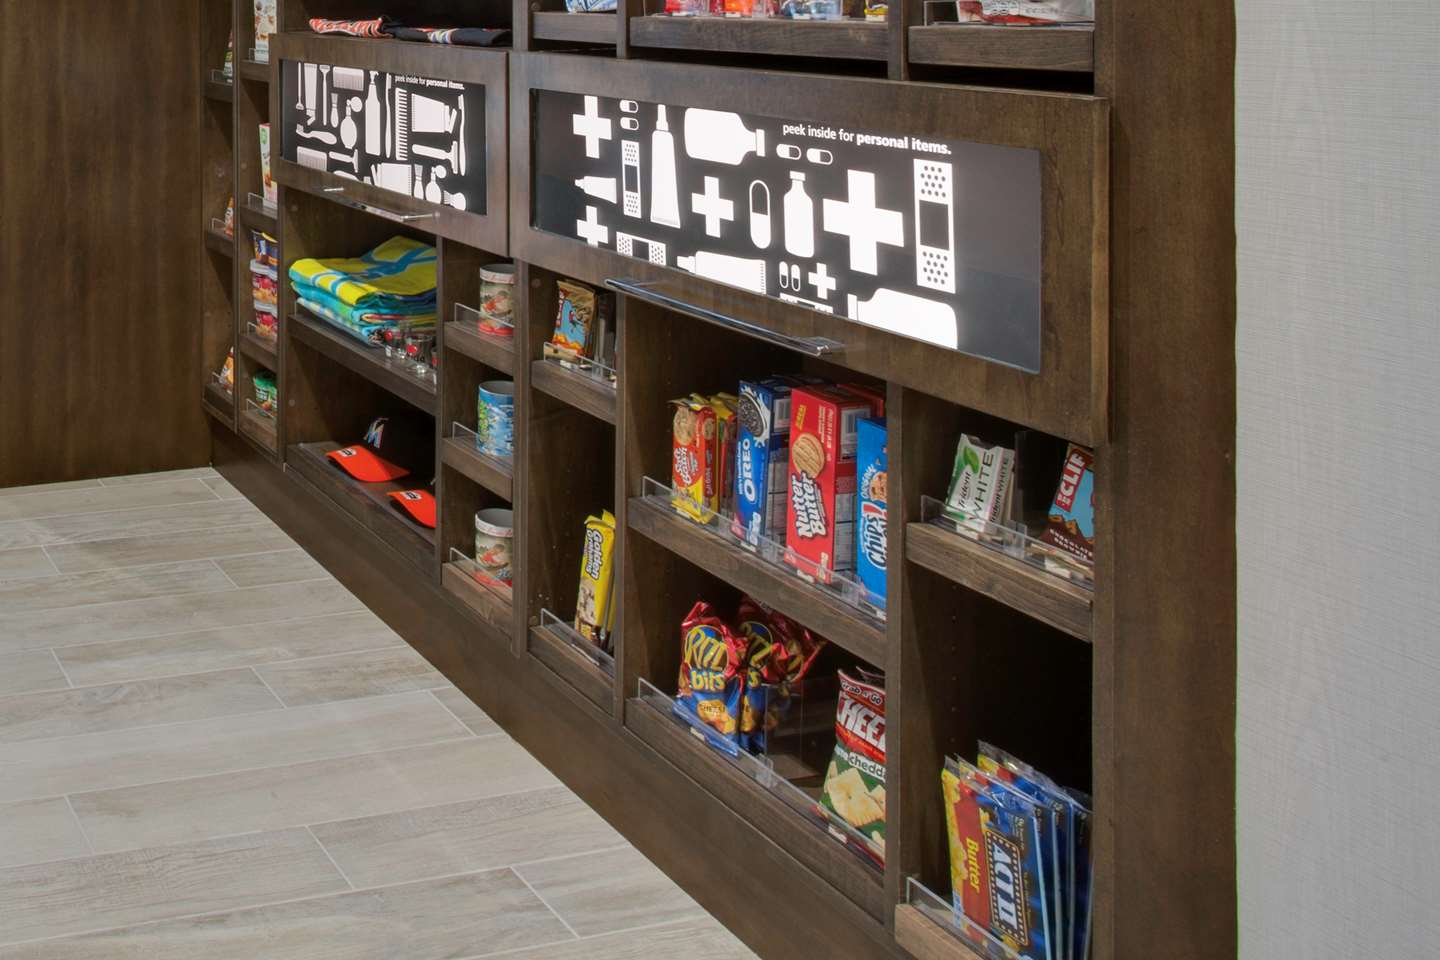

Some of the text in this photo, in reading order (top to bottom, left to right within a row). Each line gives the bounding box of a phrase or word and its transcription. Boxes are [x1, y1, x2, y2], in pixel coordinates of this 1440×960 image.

[782, 124, 952, 155] peek inside for personal items.
[742, 438, 756, 503] OREO
[969, 452, 995, 521] WHITE
[1060, 453, 1086, 498] CLIF
[791, 475, 812, 538] Nutter
[801, 471, 826, 537] Butter
[591, 528, 603, 581] Golden
[690, 669, 726, 691] bits
[848, 753, 886, 781] chedd
[966, 837, 981, 895] Butter
[991, 842, 1018, 931] ACT II
